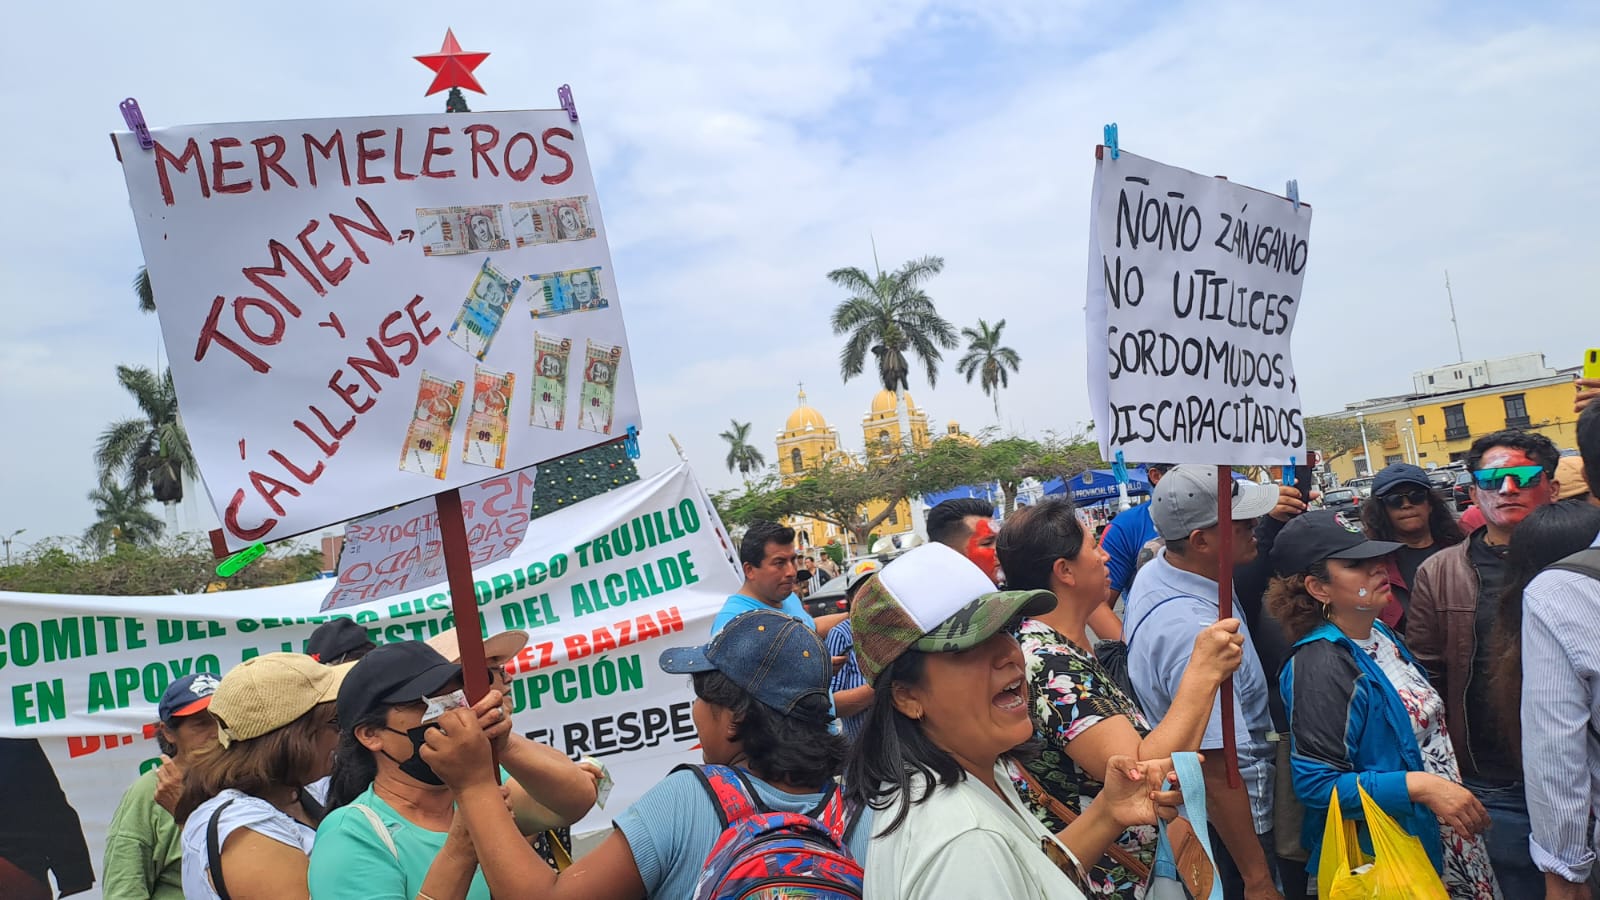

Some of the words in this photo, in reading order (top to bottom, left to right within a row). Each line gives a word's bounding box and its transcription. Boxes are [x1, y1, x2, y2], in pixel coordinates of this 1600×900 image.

[153, 124, 575, 206] MERMELEROS
[1116, 176, 1201, 251] ÑOÑO
[1215, 203, 1308, 275] ZÁNGANO
[195, 197, 393, 373] TOMEN
[1103, 255, 1144, 309] NO
[1173, 269, 1293, 335] UTILICES
[318, 311, 346, 338] Y
[1109, 326, 1284, 389] SORDOMUDOS
[574, 498, 700, 568] TRUJILLO
[12, 678, 67, 727] EN
[500, 593, 560, 631] DEL
[571, 550, 699, 618] ALCALDE
[564, 606, 684, 662] BAZAN
[563, 701, 700, 759] RESPE
